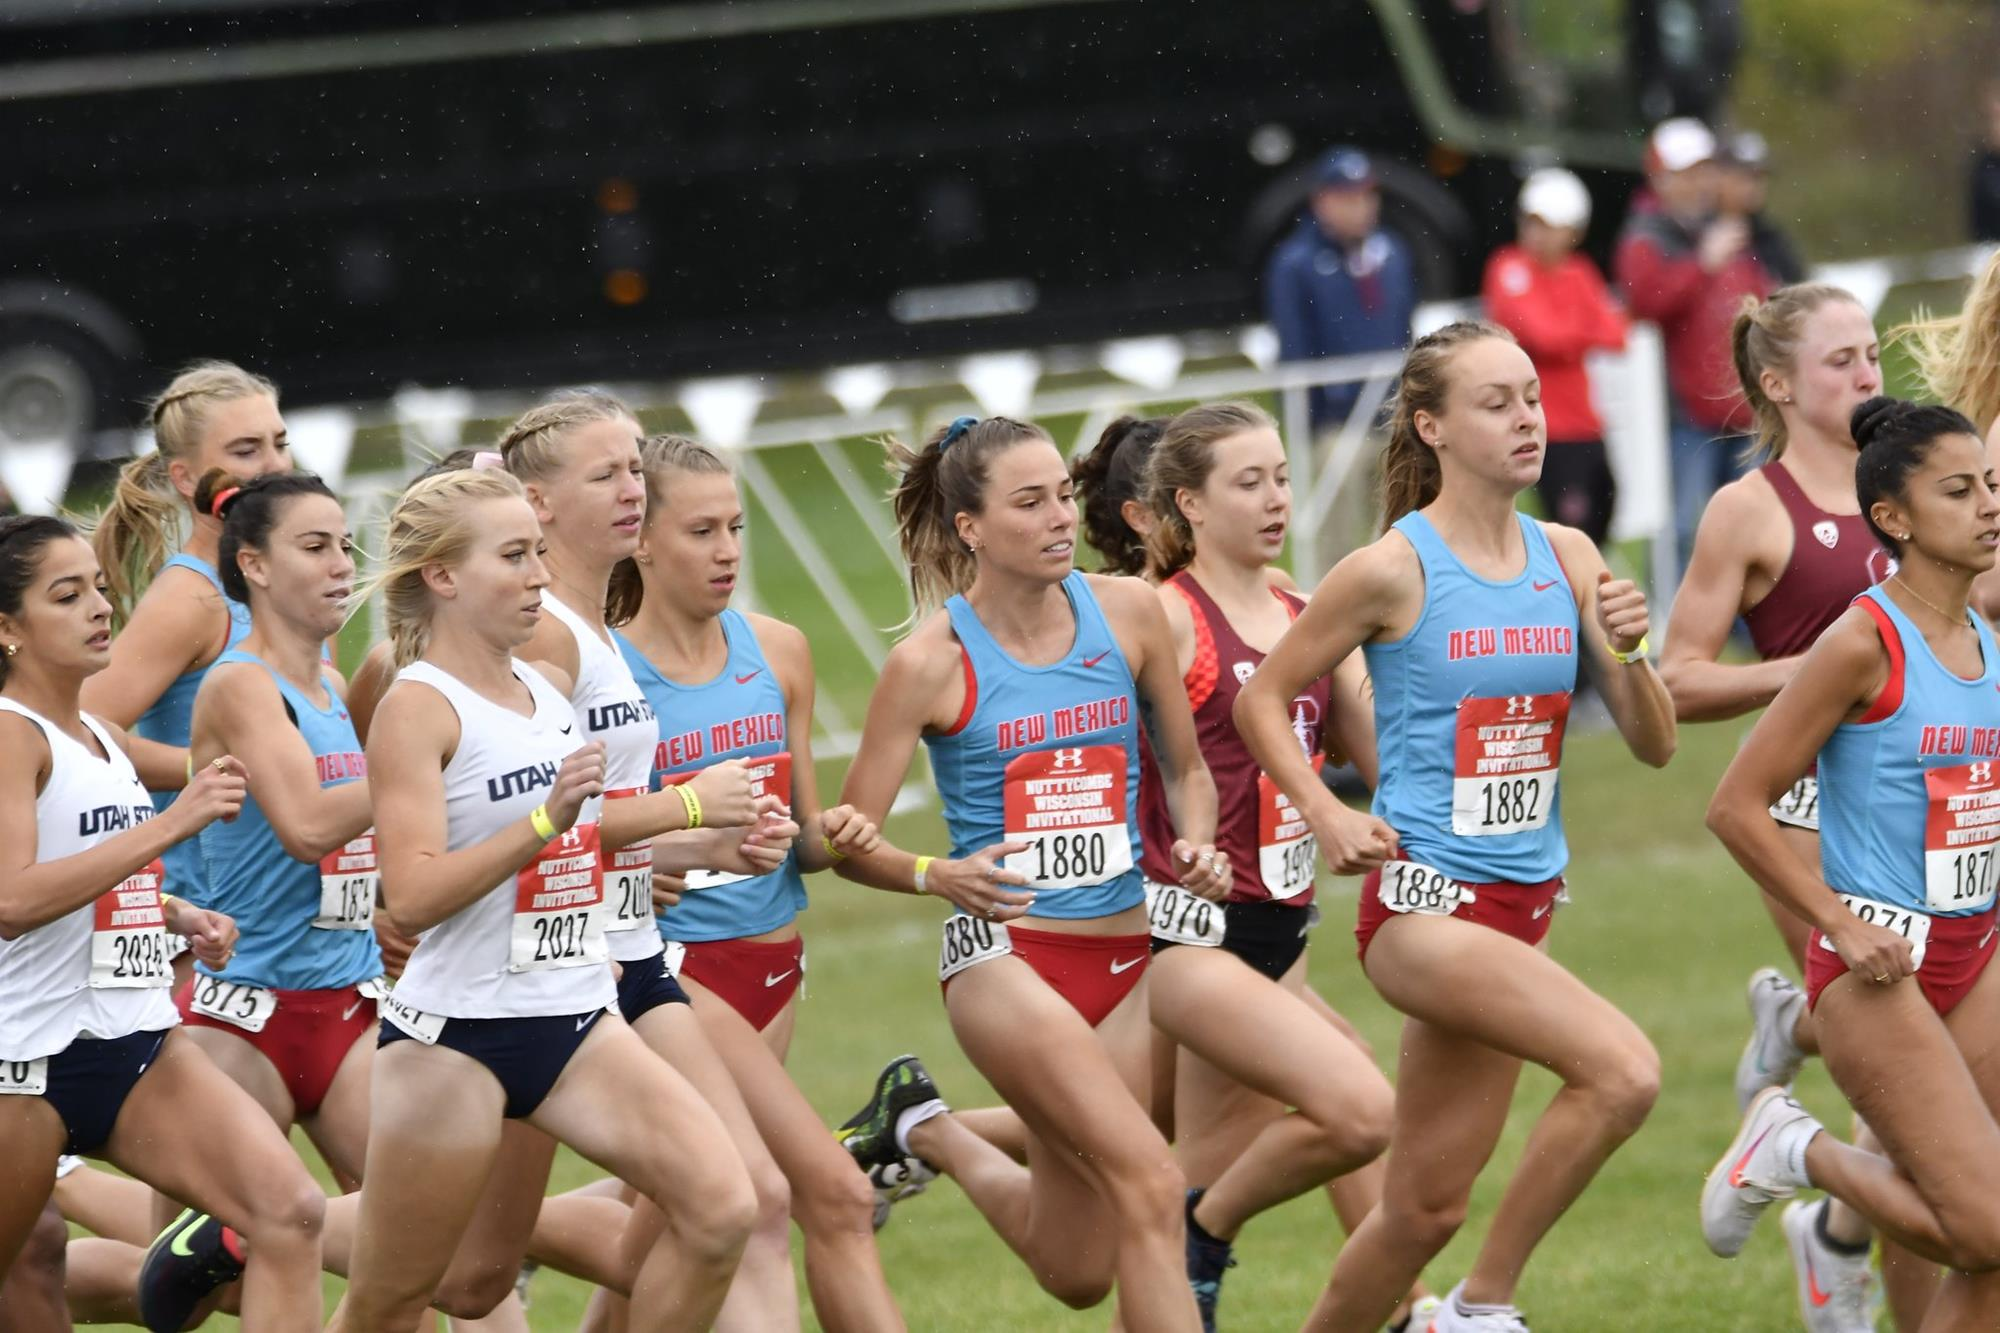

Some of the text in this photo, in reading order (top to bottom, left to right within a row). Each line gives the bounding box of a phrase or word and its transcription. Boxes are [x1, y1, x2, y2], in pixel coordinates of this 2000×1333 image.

[1448, 626, 1571, 661] NEW MEXICO
[655, 730, 704, 771] NEW
[711, 713, 784, 755] MEXICO
[998, 696, 1129, 751] NEW MEXICO
[1920, 725, 1968, 756] NEW
[488, 761, 558, 802] UTAH
[1025, 773, 1113, 796] NUTTYCOMBE
[1034, 791, 1104, 811] WISCONSIN
[1482, 778, 1539, 826] 1882
[79, 805, 131, 837] UTAH
[1026, 807, 1114, 829] INVITATIONAL
[1036, 832, 1105, 881] 1880
[1150, 885, 1211, 938] 1970
[534, 912, 589, 962] 2027
